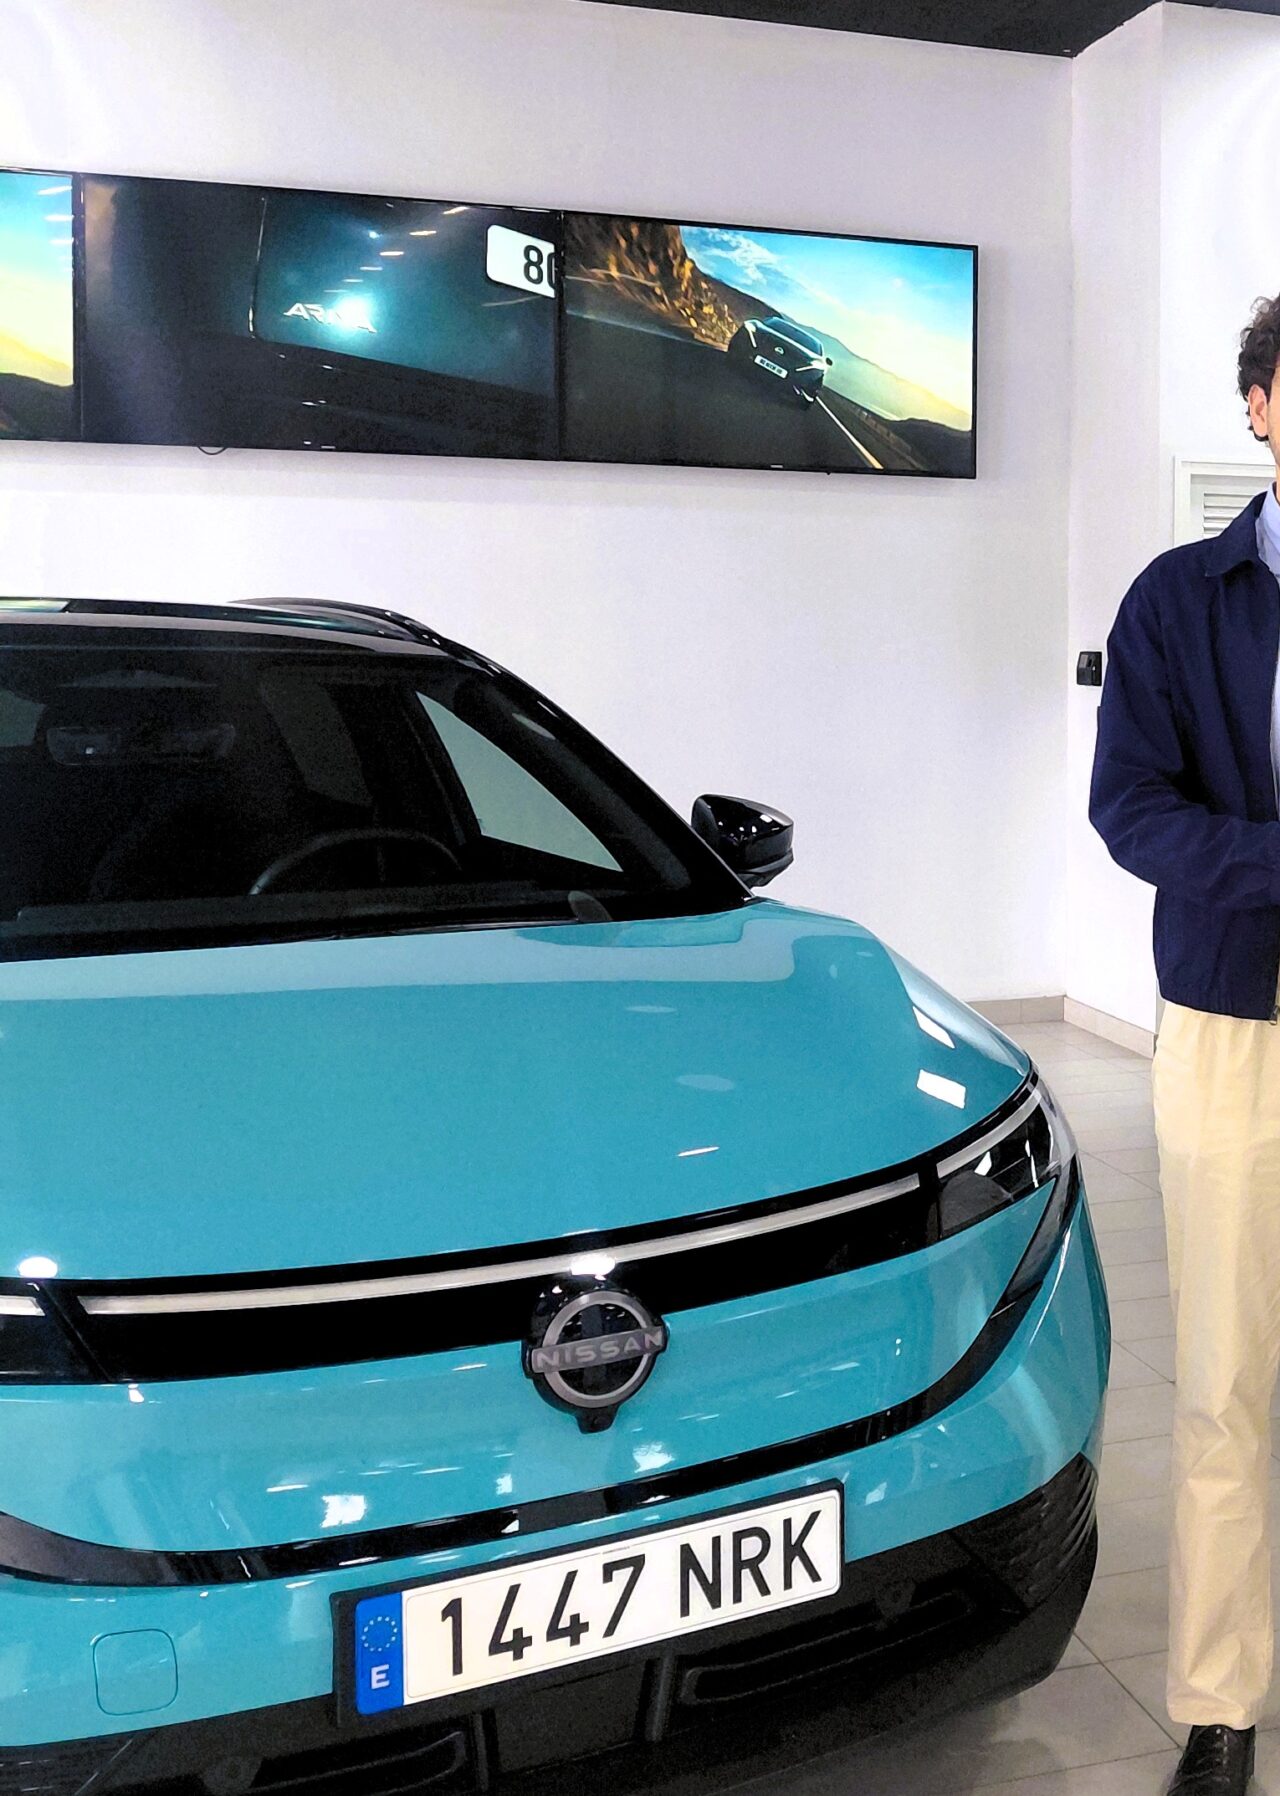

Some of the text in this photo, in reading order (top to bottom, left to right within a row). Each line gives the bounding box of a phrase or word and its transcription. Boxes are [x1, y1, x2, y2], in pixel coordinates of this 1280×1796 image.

[536, 1330, 663, 1369] NISSAN
[440, 1509, 823, 1677] 1447 NRK
[371, 1663, 391, 1690] E
